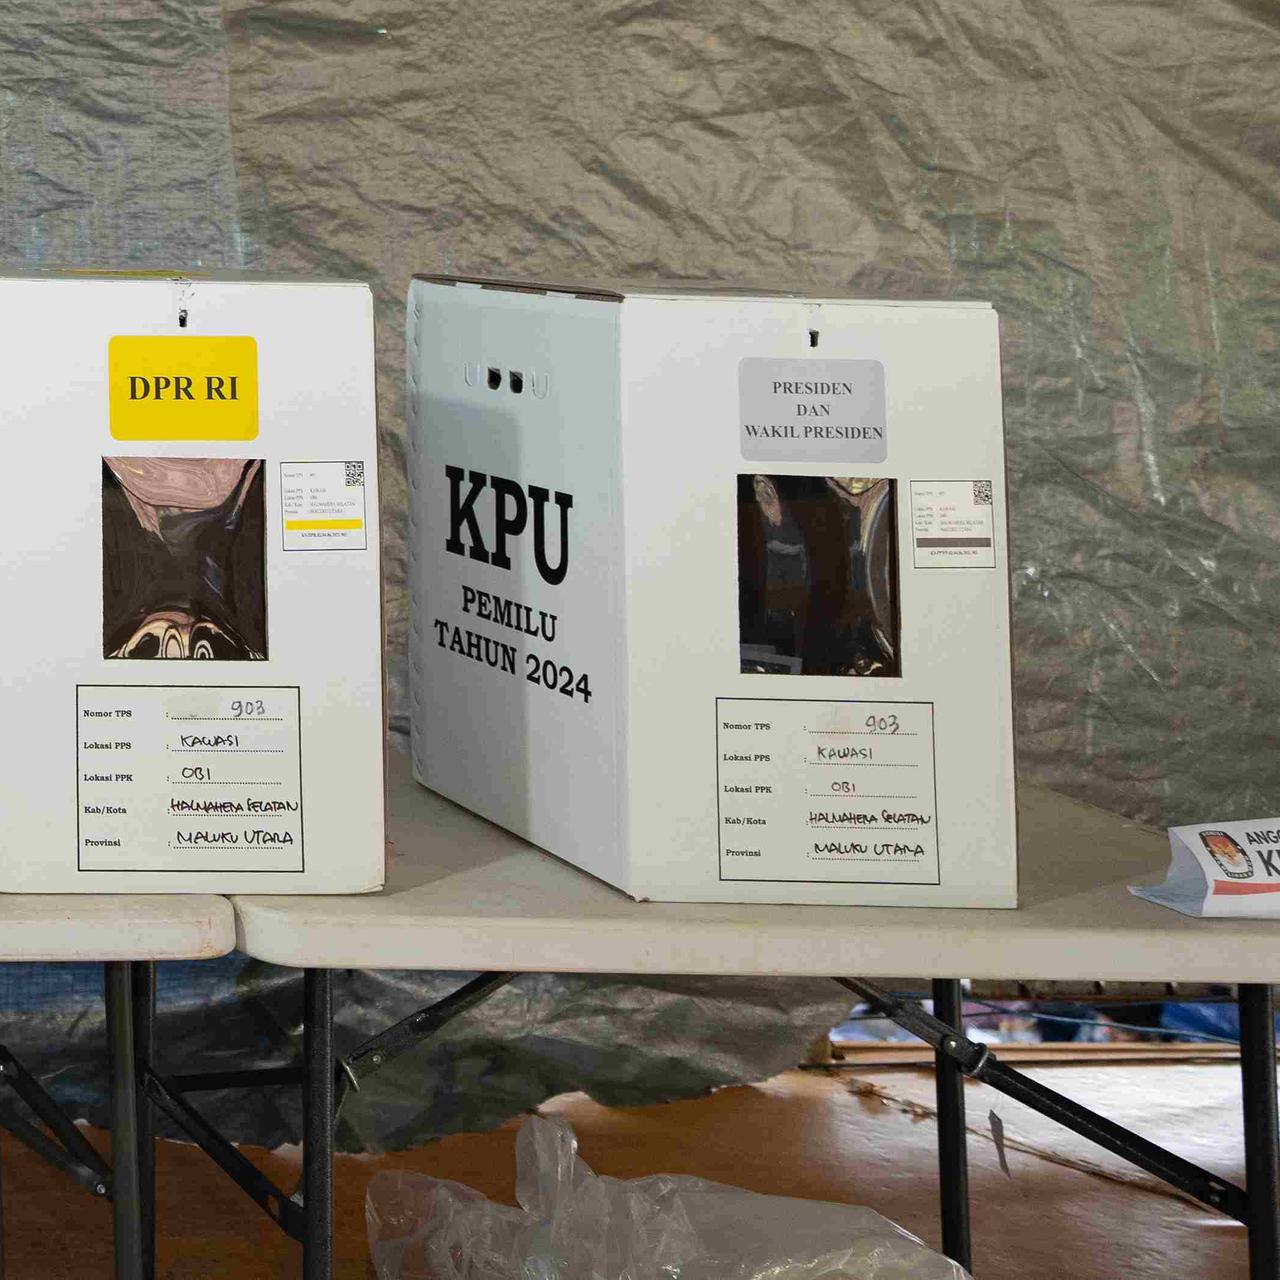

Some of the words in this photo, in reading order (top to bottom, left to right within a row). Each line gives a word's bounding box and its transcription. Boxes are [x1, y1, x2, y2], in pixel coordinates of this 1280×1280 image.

[128, 376, 195, 401] DPR
[206, 376, 239, 401] RI
[772, 382, 853, 395] PRESIDEN
[796, 404, 830, 416] DAN
[744, 425, 800, 438] WAKIL
[804, 426, 883, 440] PRESIDEN
[445, 464, 573, 586] KPU
[462, 584, 557, 642] PEMILU
[434, 618, 517, 675] TAHUN
[526, 654, 592, 703] 2024
[83, 710, 112, 718] Nomor
[115, 710, 132, 718] TPS
[231, 700, 265, 717] 903
[723, 723, 752, 731] Nomor
[754, 723, 771, 731] TPS
[865, 714, 899, 735] 903
[83, 742, 113, 750] Lokasi
[115, 742, 132, 750] PPS
[181, 735, 239, 747] KAWASI
[723, 754, 752, 762] Lokasi
[754, 754, 771, 762] PPS
[817, 746, 873, 760] KAWASI
[84, 774, 113, 782] Lokasi
[115, 774, 133, 782] PPK
[182, 767, 211, 780] OBI
[724, 785, 752, 793] Lokasi
[755, 785, 772, 793] PPK
[831, 782, 856, 793] OBI
[84, 806, 127, 815] Kab/Kota
[724, 817, 767, 826] Kab/Kota
[809, 812, 878, 824] HALMAHERA
[84, 839, 121, 847] Provinsi
[177, 831, 239, 844] MALUKU
[244, 830, 294, 845] UTARA
[726, 849, 761, 857] Provinsi
[814, 843, 868, 855] MALUKU
[874, 843, 925, 857] UTARA
[1256, 850, 1280, 877] K
